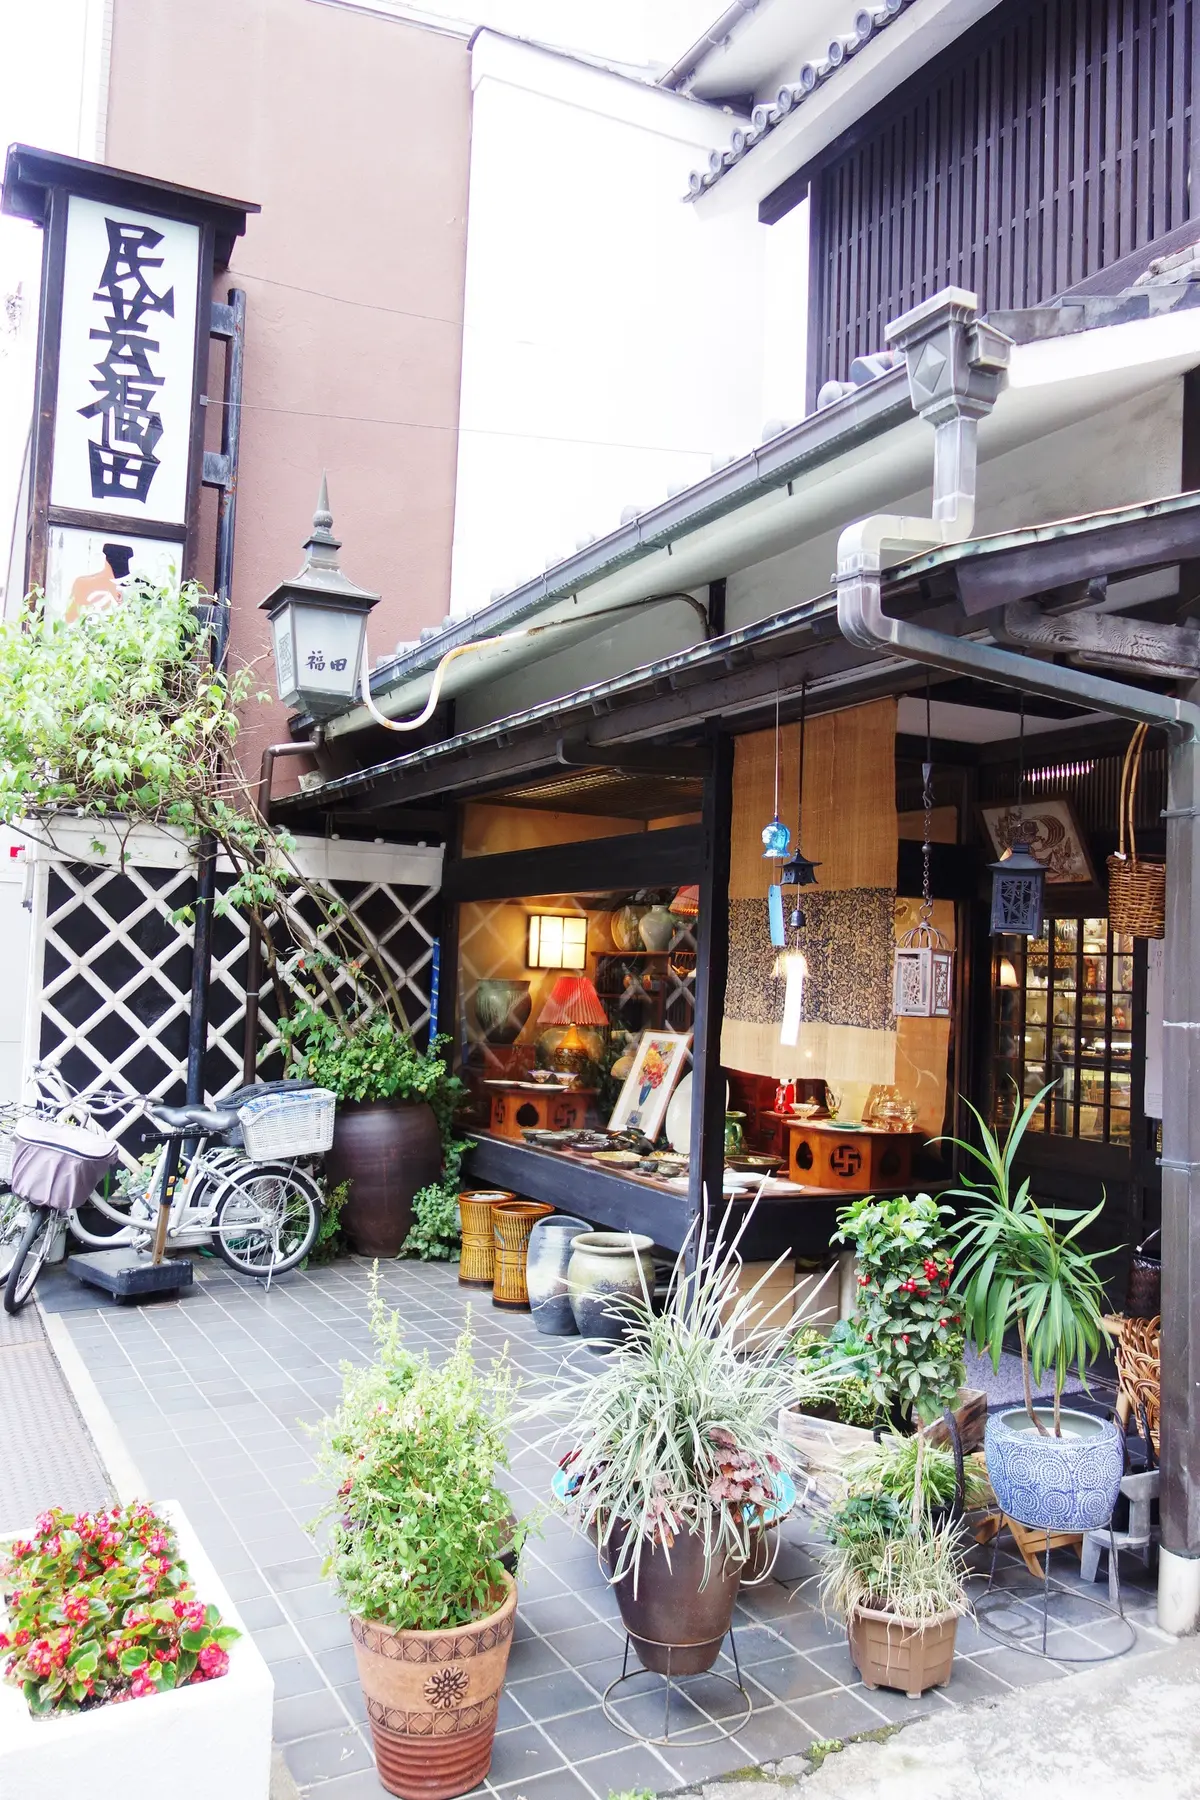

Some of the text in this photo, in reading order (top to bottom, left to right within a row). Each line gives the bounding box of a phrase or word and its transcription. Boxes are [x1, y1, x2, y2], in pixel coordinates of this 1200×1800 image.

[76, 217, 174, 504] 民芸福田
[305, 650, 348, 672] 福田
